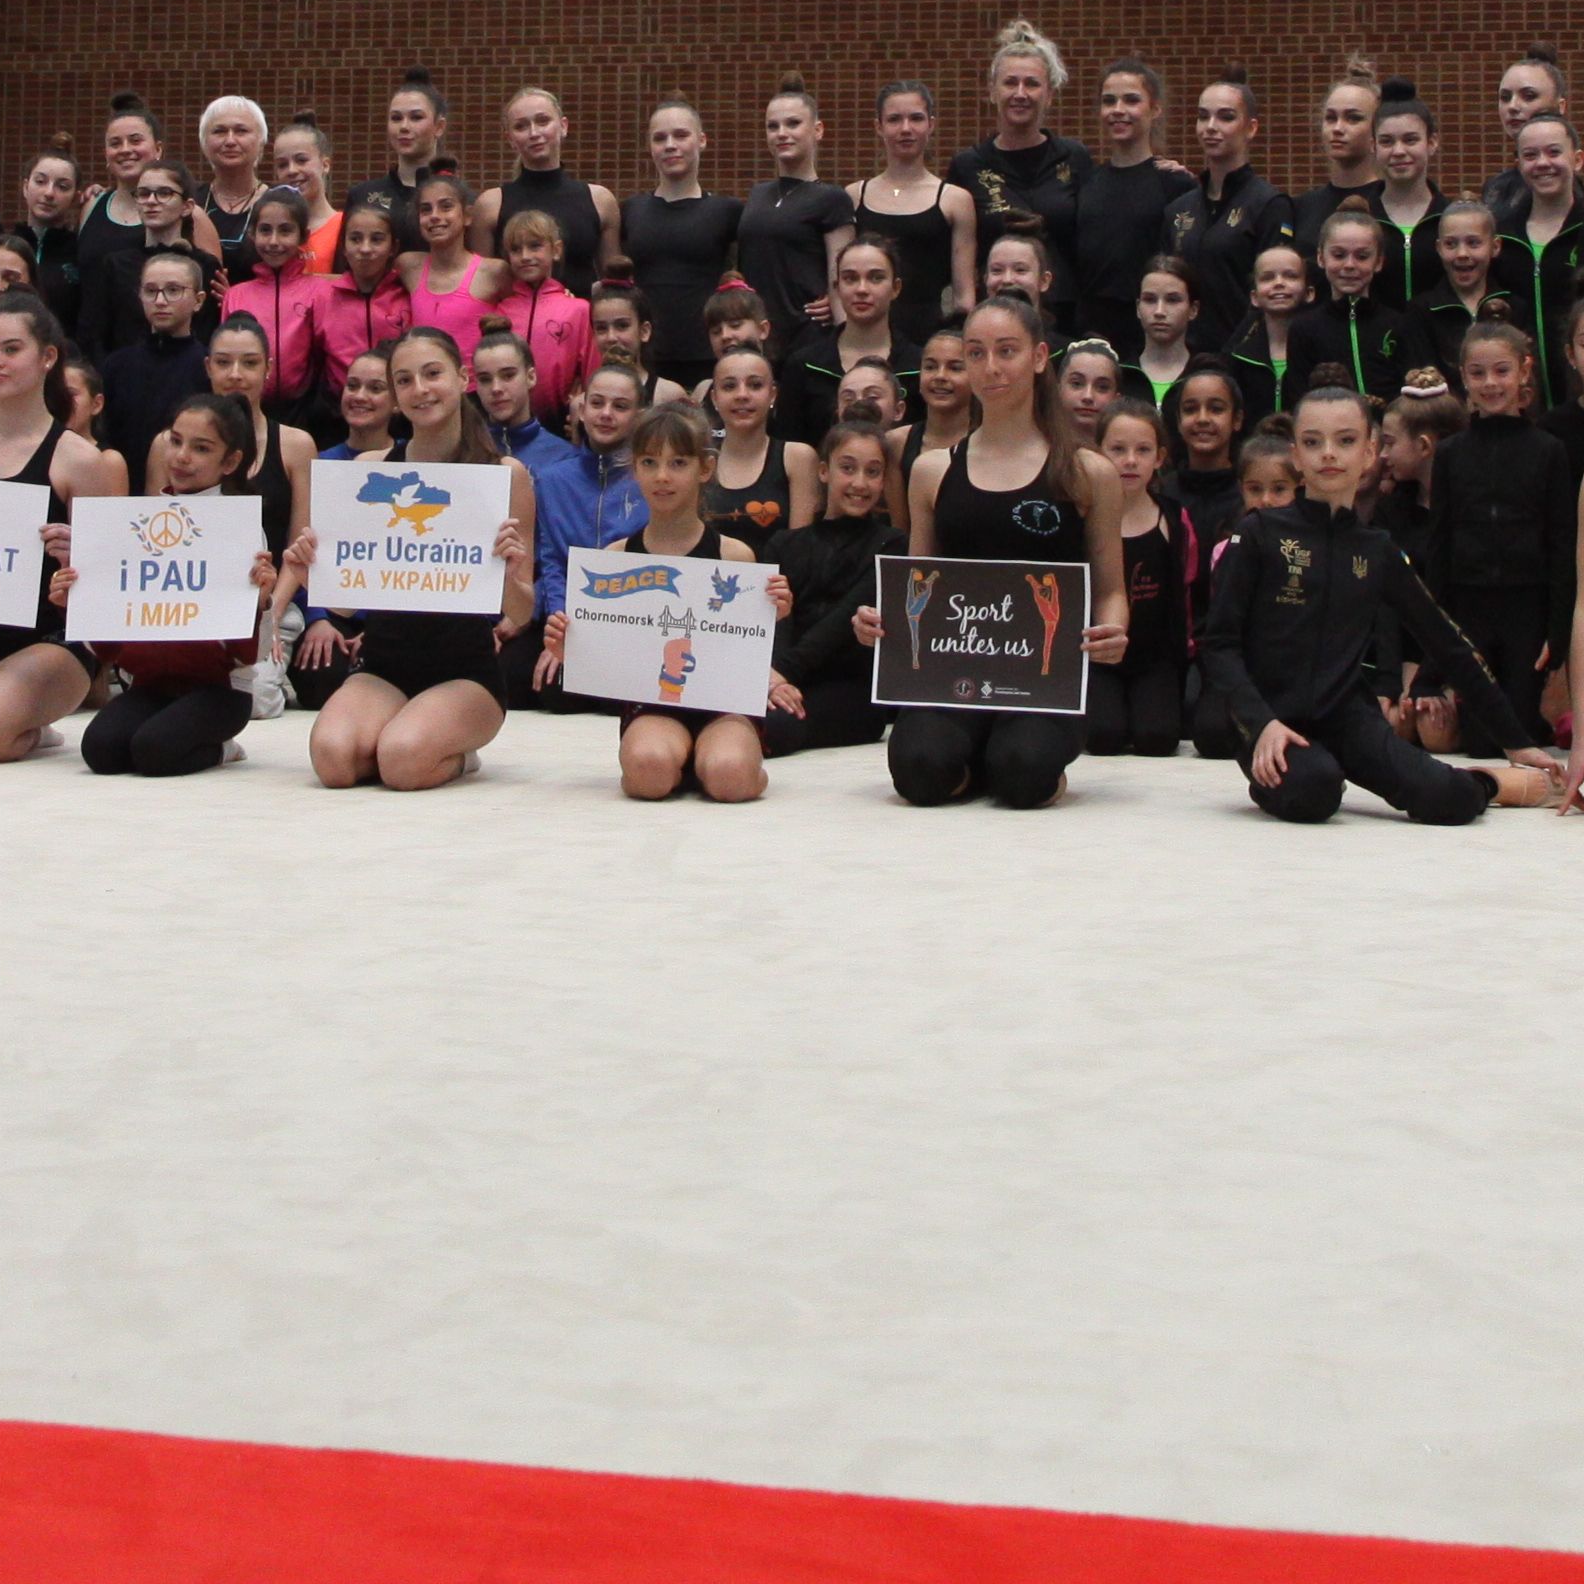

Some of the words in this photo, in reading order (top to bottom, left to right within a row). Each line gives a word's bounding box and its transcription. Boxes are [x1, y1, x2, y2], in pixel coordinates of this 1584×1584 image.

[335, 539, 378, 566] per
[385, 536, 483, 565] Ucraïna
[120, 559, 128, 592] i
[139, 559, 208, 592] PAU
[339, 568, 367, 590] ЗА
[379, 567, 472, 593] УКРАЇНУ
[593, 569, 669, 595] PEACE
[140, 602, 200, 627] МИР
[574, 607, 655, 628] Chornomorsk
[699, 620, 767, 639] Cerdanyola
[945, 593, 1015, 634] Sport
[930, 626, 1001, 657] unites
[1004, 639, 1035, 658] us
